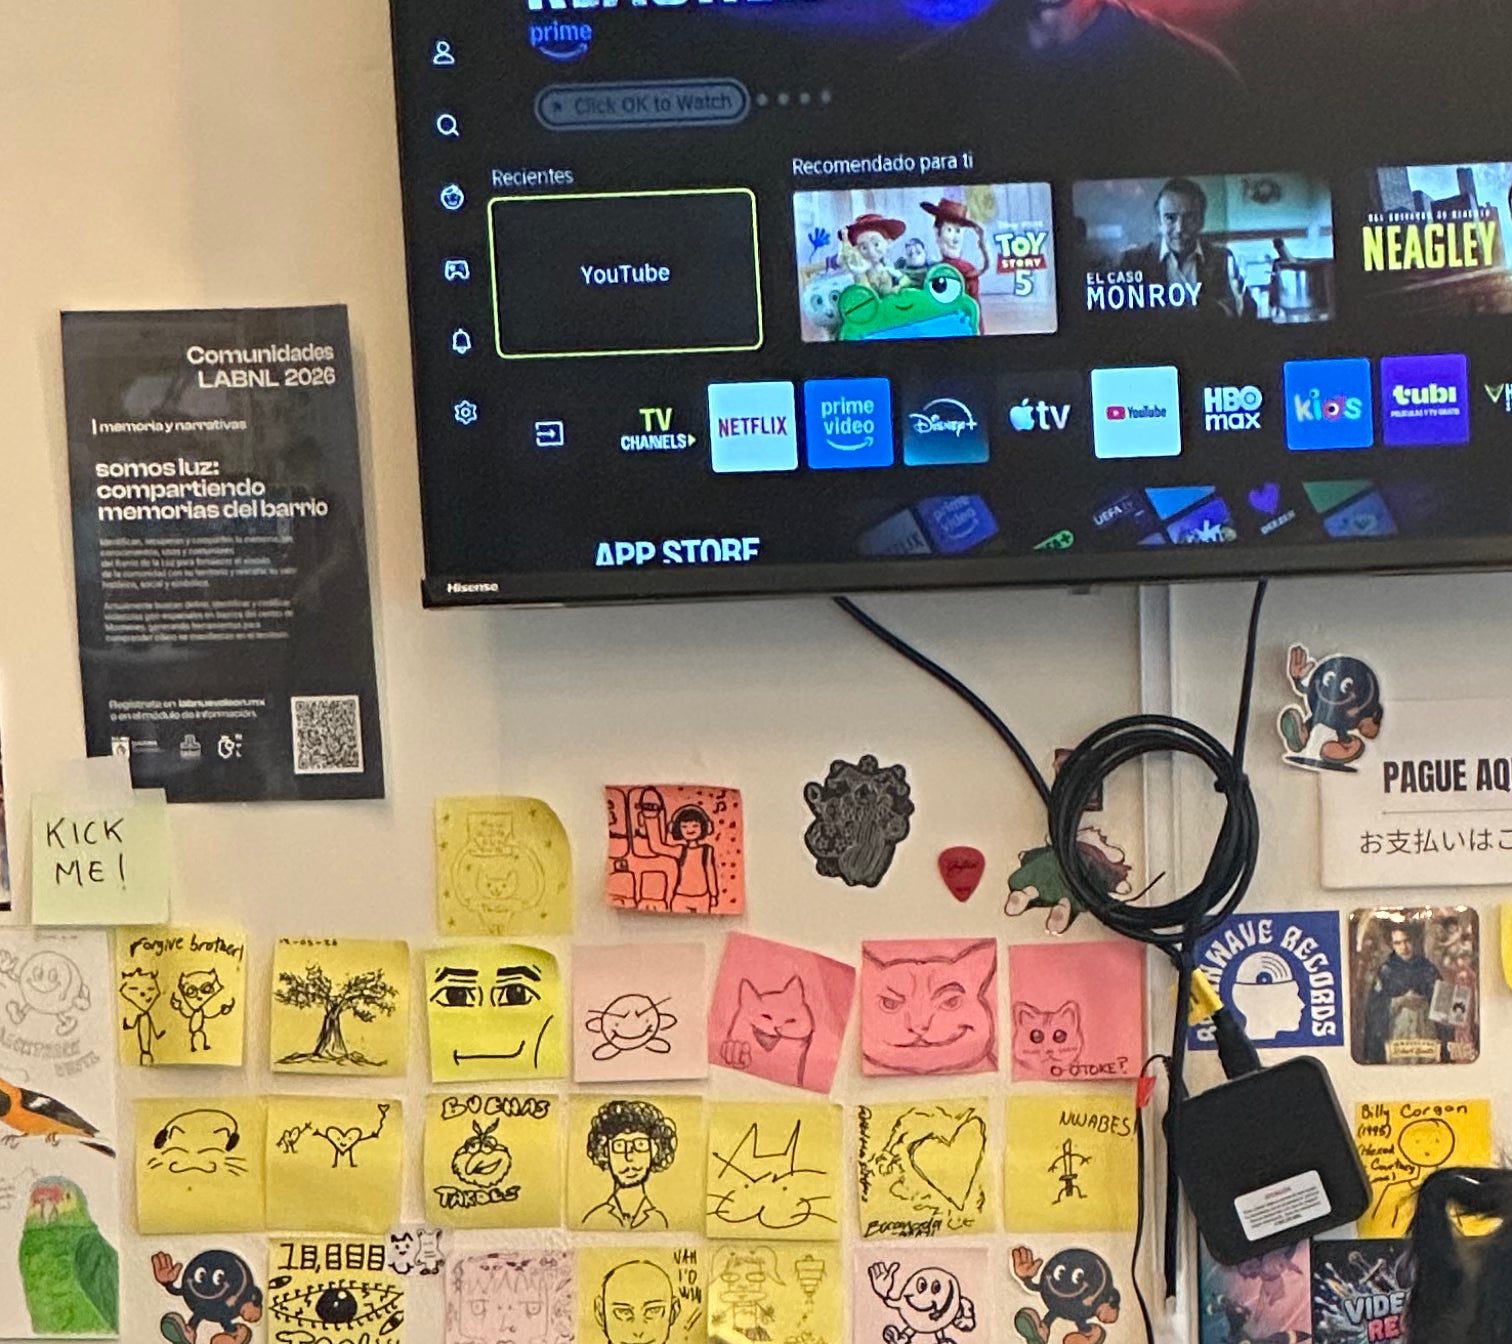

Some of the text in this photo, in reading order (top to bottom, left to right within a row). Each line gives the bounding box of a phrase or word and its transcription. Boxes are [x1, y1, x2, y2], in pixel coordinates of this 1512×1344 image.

[530, 22, 592, 47] prime
[575, 92, 733, 115] Click OK to Watch
[792, 153, 973, 175] Recomendado para ti
[492, 168, 574, 187] Recientes
[995, 231, 1047, 257] TOY
[1362, 221, 1497, 271] NEAGLEY
[581, 264, 670, 284] YouTube
[1002, 258, 1041, 268] STORY
[1015, 270, 1033, 296] 5
[1087, 271, 1143, 285] EL CASO
[1087, 282, 1202, 310] MONROY
[187, 344, 334, 365] Comunidades
[198, 367, 336, 388] LABNL 2026
[1204, 386, 1262, 412] HBO
[1295, 388, 1362, 421] kids
[1393, 384, 1456, 404] tubi
[821, 398, 874, 419] prime
[1036, 402, 1070, 430] tv
[1128, 405, 1166, 419] YouTube
[100, 419, 247, 433] memoria y narrativas
[640, 408, 673, 432] TV
[718, 416, 787, 437] NETFLIX
[824, 419, 874, 434] video
[1205, 412, 1261, 431] max
[621, 434, 686, 451] CHANNELS
[96, 459, 219, 477] somos luz:
[97, 479, 266, 502] compartiendo
[98, 498, 328, 521] memorias del barrio
[596, 540, 655, 566] APP
[447, 582, 499, 593] Hisense
[1383, 759, 1467, 793] PAGUE
[46, 817, 125, 848] KICK
[55, 854, 127, 893] ME!
[1280, 925, 1336, 1037] RECORDS
[1361, 1104, 1390, 1126] Billy
[1344, 1292, 1405, 1324] VIDE
